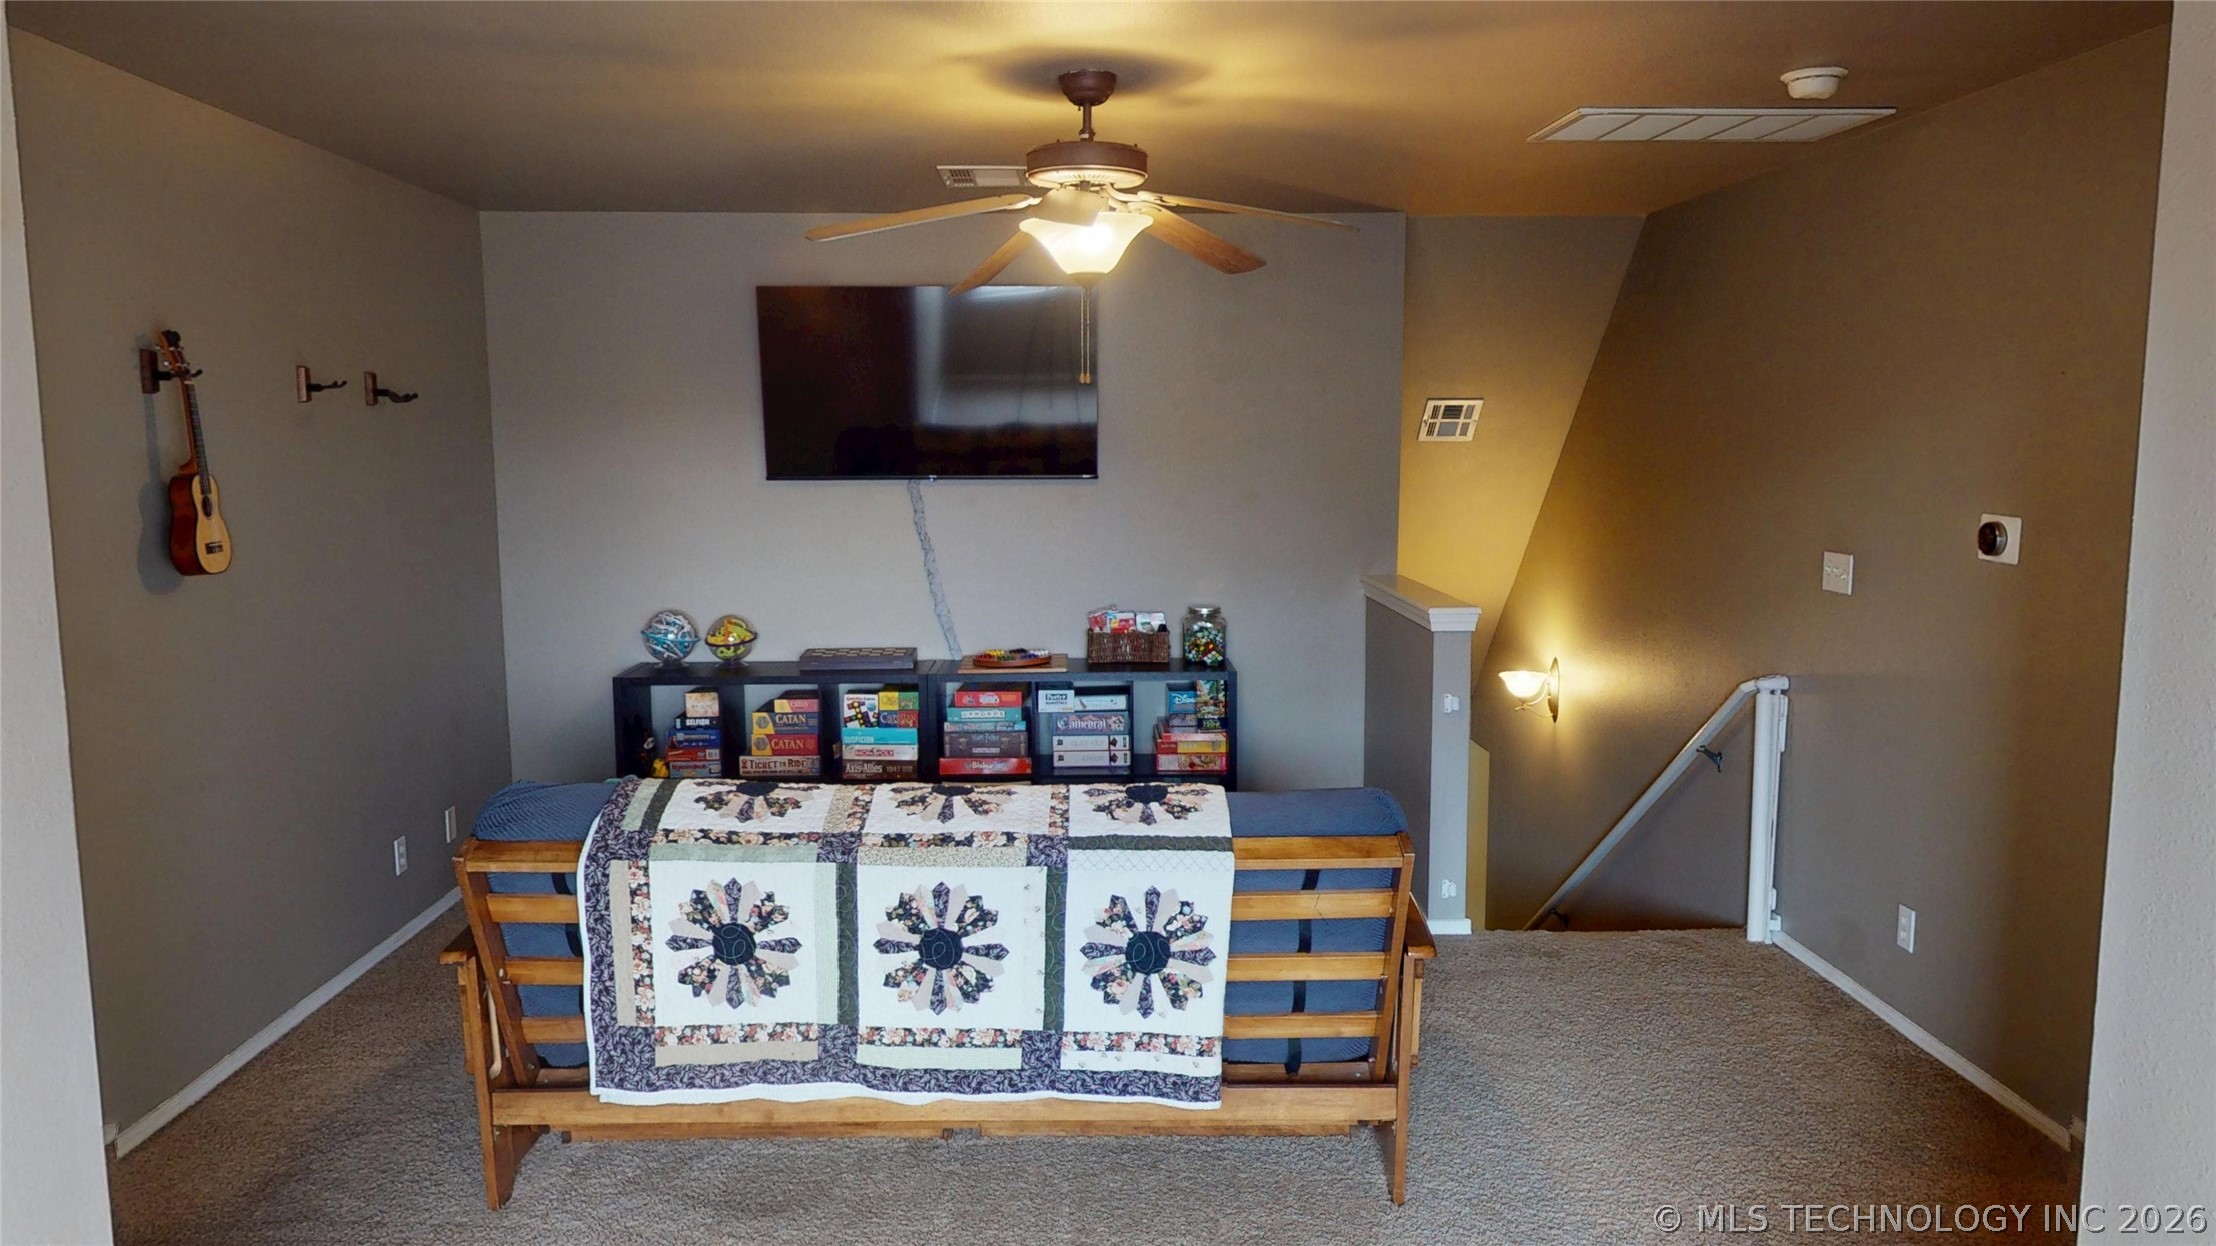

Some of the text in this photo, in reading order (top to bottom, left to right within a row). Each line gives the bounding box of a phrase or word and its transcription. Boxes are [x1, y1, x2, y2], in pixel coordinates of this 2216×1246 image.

[775, 714, 806, 724] CATAN
[1056, 718, 1107, 730] Cathedral
[771, 739, 804, 750] CATAN
[749, 760, 777, 769] TICKET
[788, 759, 805, 768] RIDE
